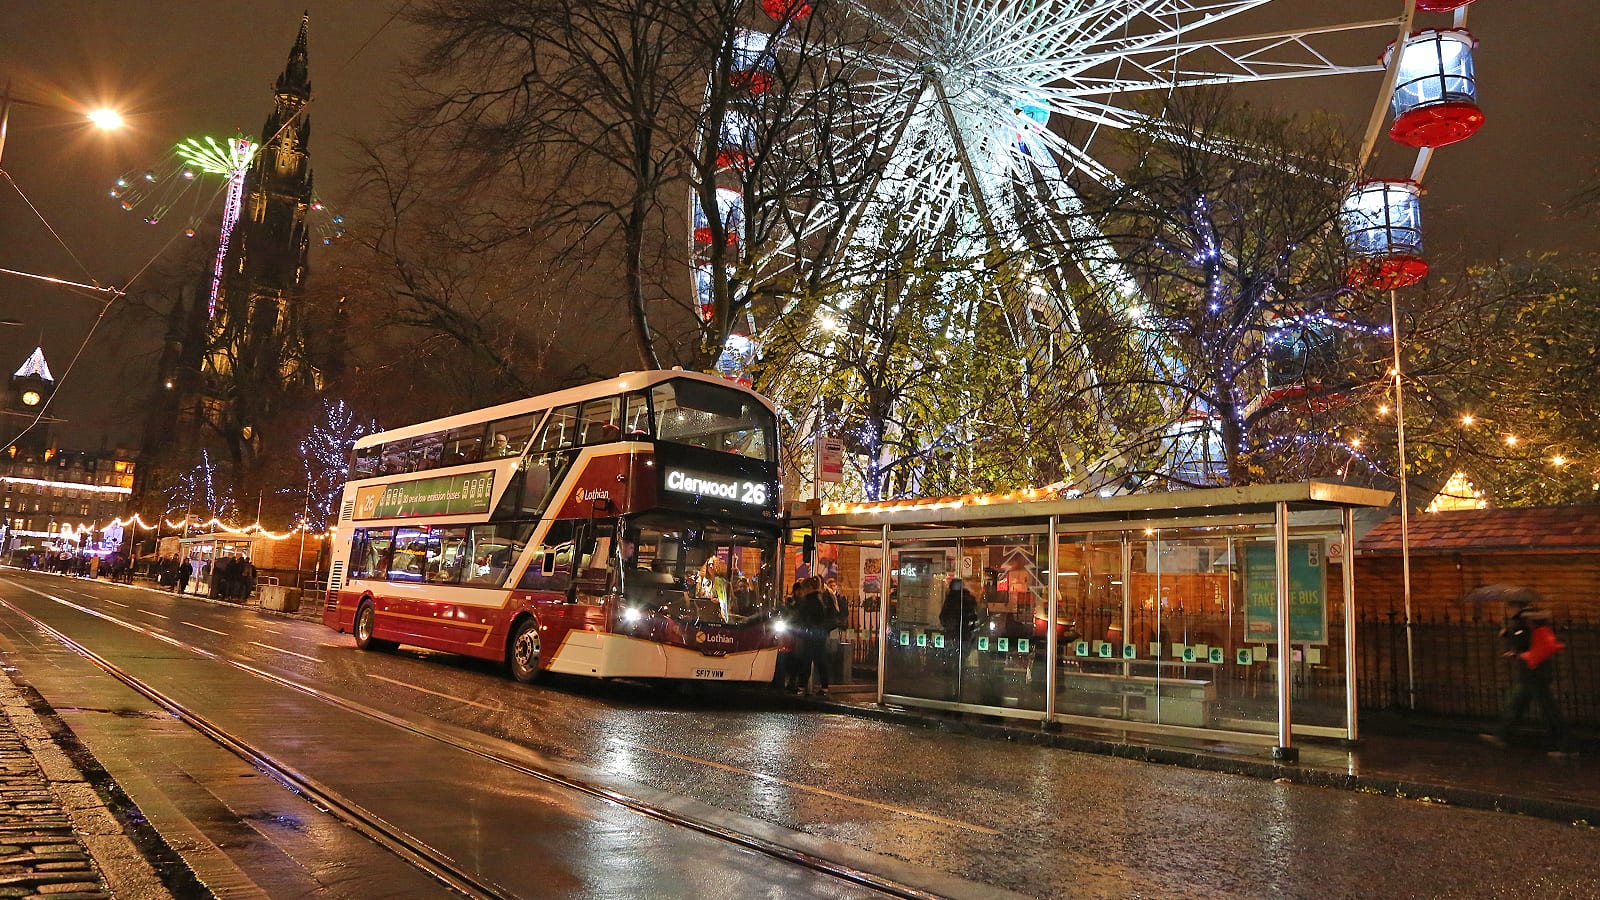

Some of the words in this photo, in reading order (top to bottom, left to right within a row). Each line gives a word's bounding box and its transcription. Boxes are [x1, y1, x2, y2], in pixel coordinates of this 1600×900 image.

[668, 471, 738, 498] Clerwood
[741, 482, 766, 504] 26
[427, 491, 446, 501] emission
[446, 490, 461, 500] buses
[585, 488, 609, 500] Lothian
[1252, 592, 1275, 606] TAKE
[1299, 590, 1319, 604] BUS
[707, 633, 734, 644] Lothian
